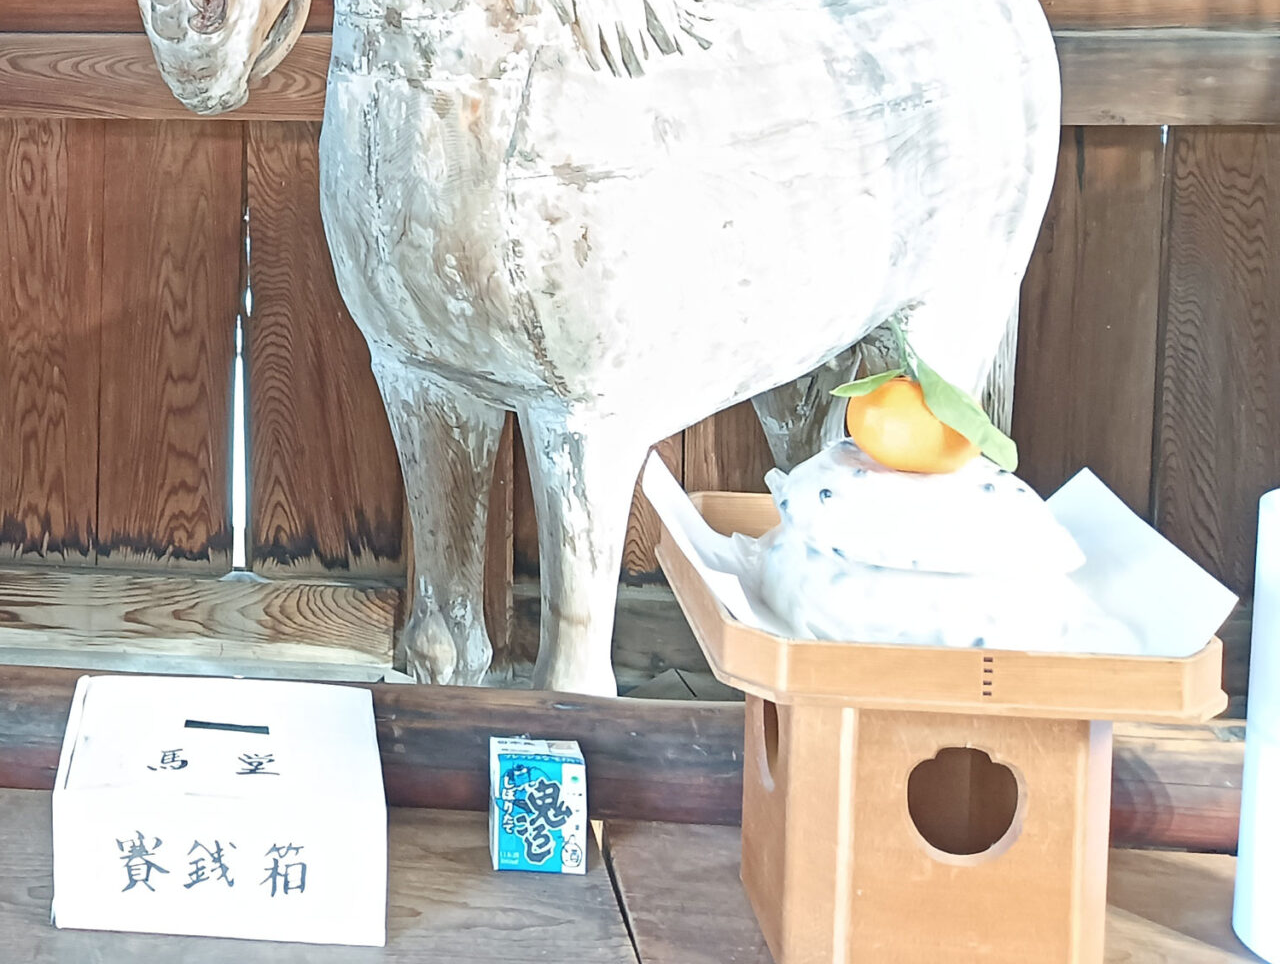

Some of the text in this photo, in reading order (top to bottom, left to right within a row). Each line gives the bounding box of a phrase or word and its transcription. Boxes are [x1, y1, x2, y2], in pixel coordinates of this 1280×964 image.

[515, 777, 574, 864] 鬼ころし
[116, 830, 308, 898] 賽銭箱
